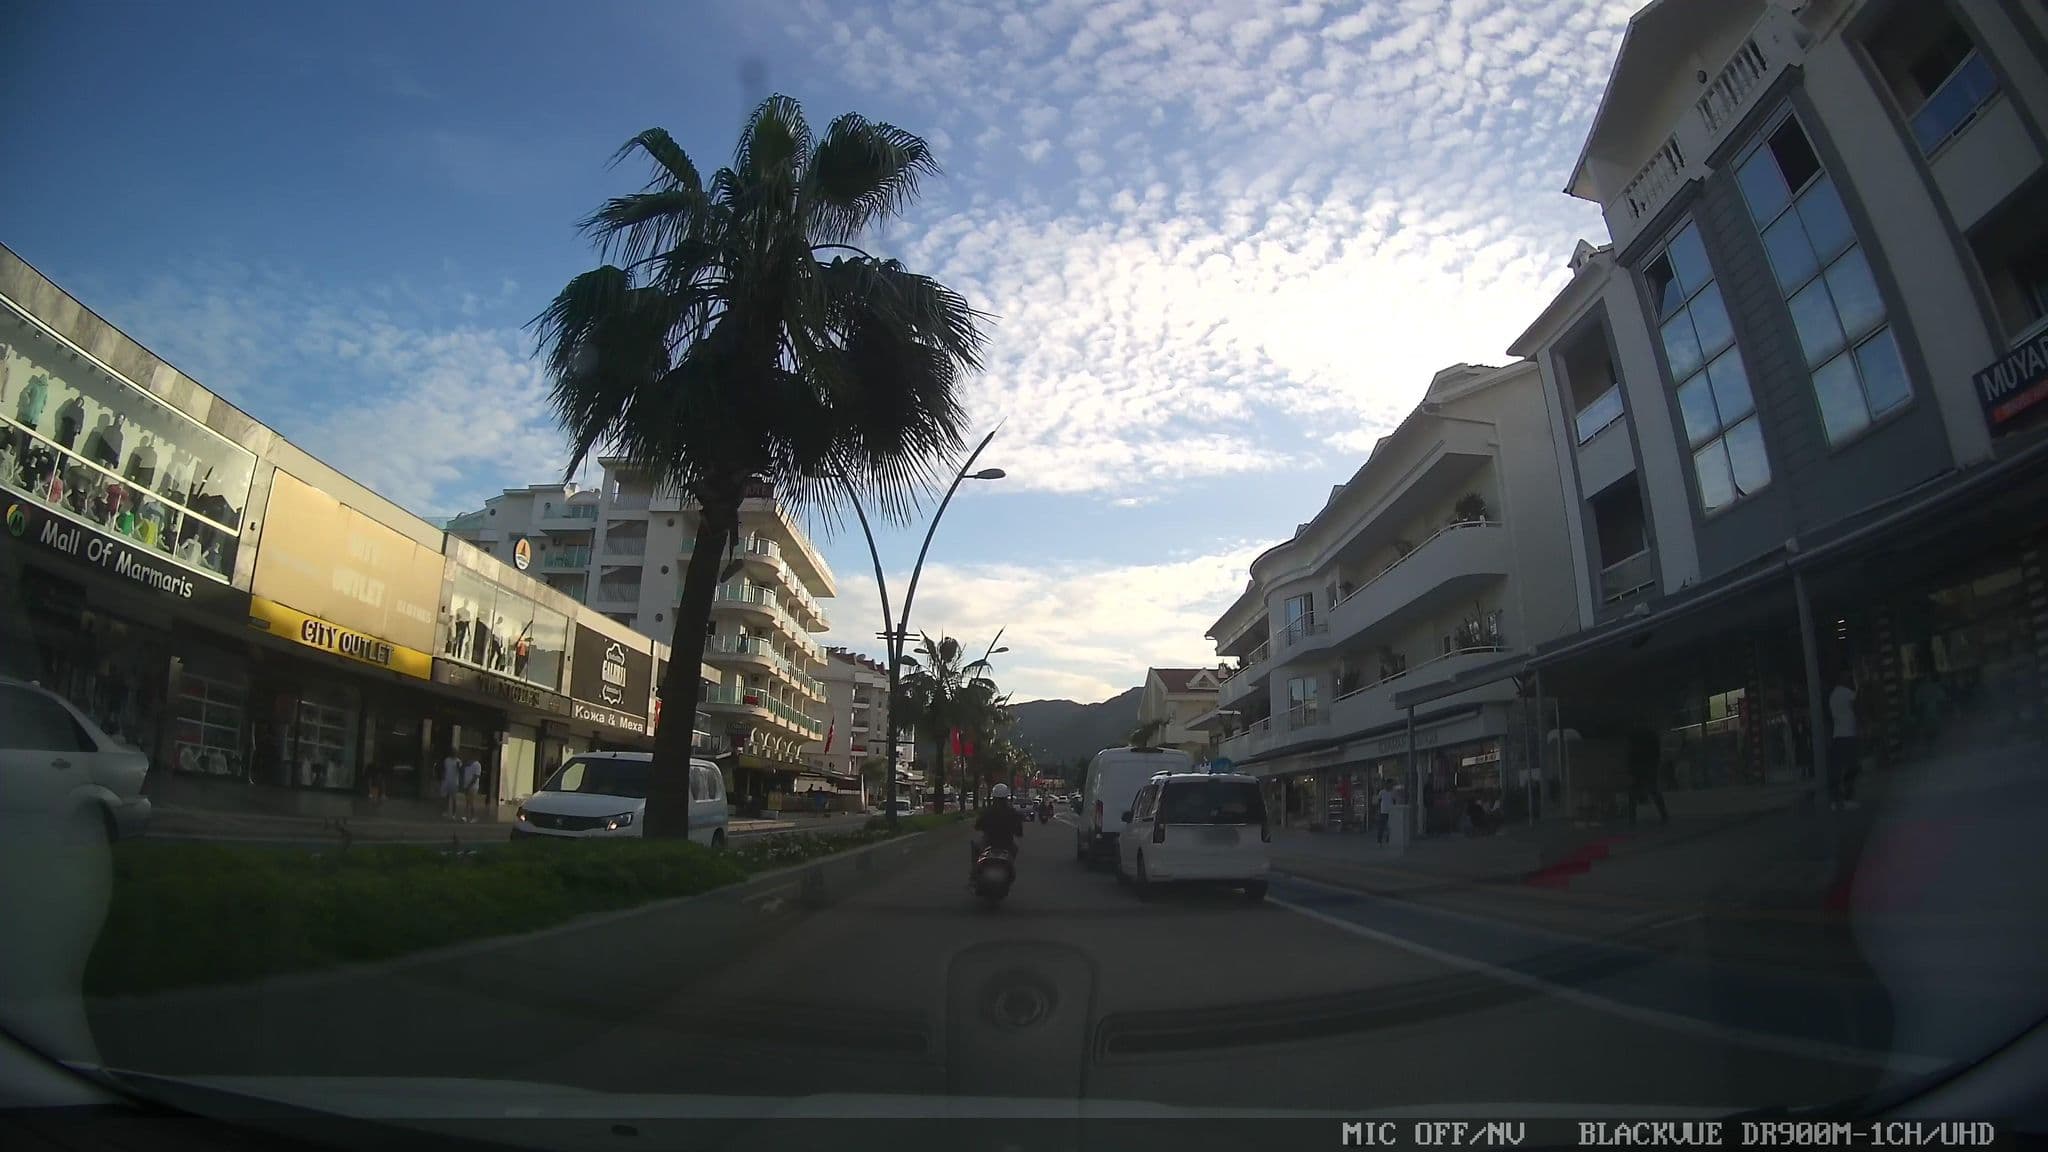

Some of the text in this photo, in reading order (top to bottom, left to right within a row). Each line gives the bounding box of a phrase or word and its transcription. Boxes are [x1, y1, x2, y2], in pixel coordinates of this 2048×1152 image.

[40, 519, 193, 598] Mall Of Marmaris
[303, 619, 395, 665] CITY OUTLET
[575, 705, 643, 732] Кожа & Меха
